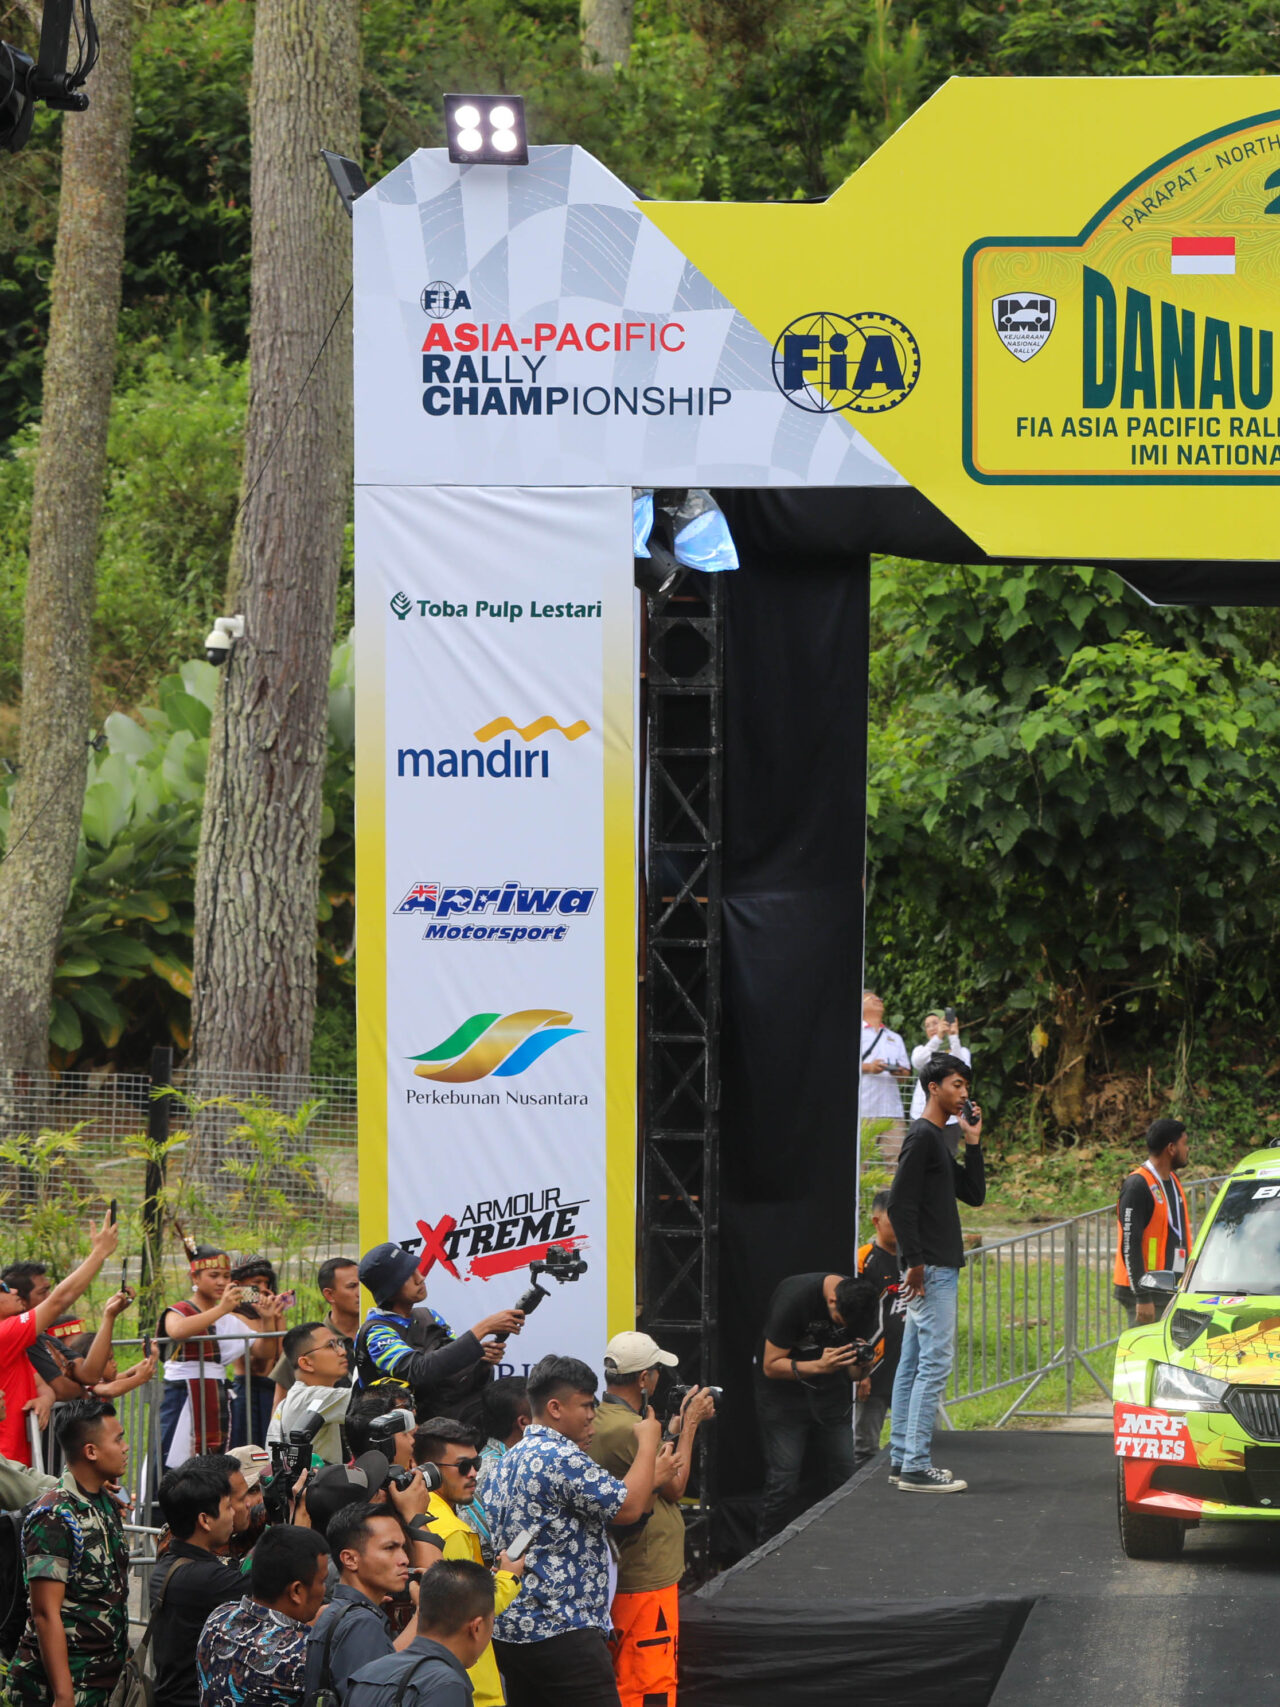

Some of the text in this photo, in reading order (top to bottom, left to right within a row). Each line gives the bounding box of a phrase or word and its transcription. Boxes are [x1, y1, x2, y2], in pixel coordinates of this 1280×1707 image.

[1121, 166, 1198, 232] PARAPAT
[421, 322, 685, 353] ASIA-PACIFIC
[1082, 264, 1273, 410] DANAU
[422, 355, 546, 383] RALLY
[422, 386, 732, 416] CHAMPIONSHIP
[1016, 416, 1055, 438] FIA
[1060, 416, 1118, 438] ASIA
[1127, 416, 1220, 438] PACIFIC
[1131, 445, 1170, 466] IMI
[417, 600, 602, 622] Toba Pulp Lestari
[397, 739, 549, 778] mandiri
[394, 881, 599, 919] Apriwa
[422, 923, 570, 942] Motorsport
[406, 1089, 588, 1106] Perkebunan Nusantara
[460, 1188, 561, 1228] ARMOUR
[1118, 1413, 1188, 1437] MRF
[1116, 1436, 1186, 1460] TYRES
